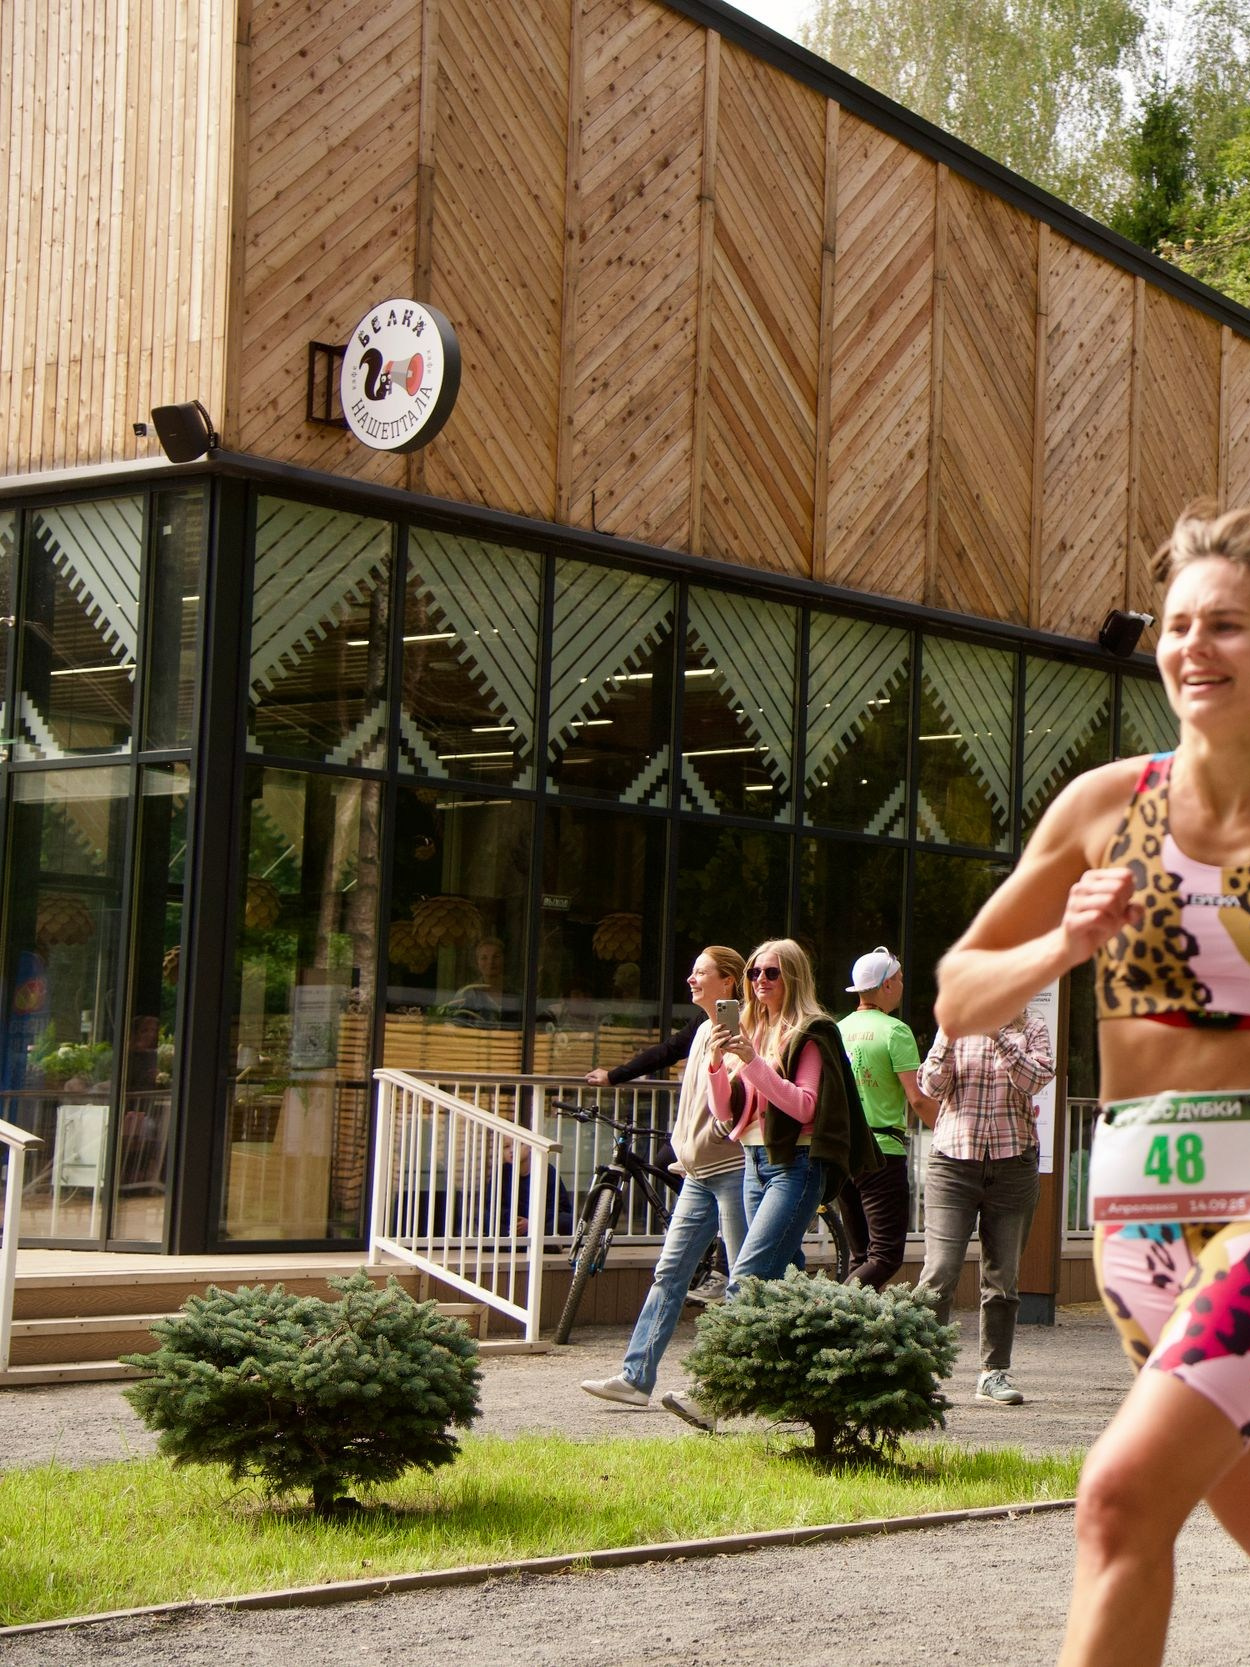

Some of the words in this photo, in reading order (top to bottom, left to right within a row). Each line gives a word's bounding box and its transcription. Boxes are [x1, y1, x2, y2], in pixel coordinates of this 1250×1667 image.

[358, 309, 427, 348] БЕЛКА
[351, 386, 433, 440] НАШЕПТАЛА
[1176, 1102, 1242, 1121] ДУБКИ
[1144, 1133, 1206, 1184] 48
